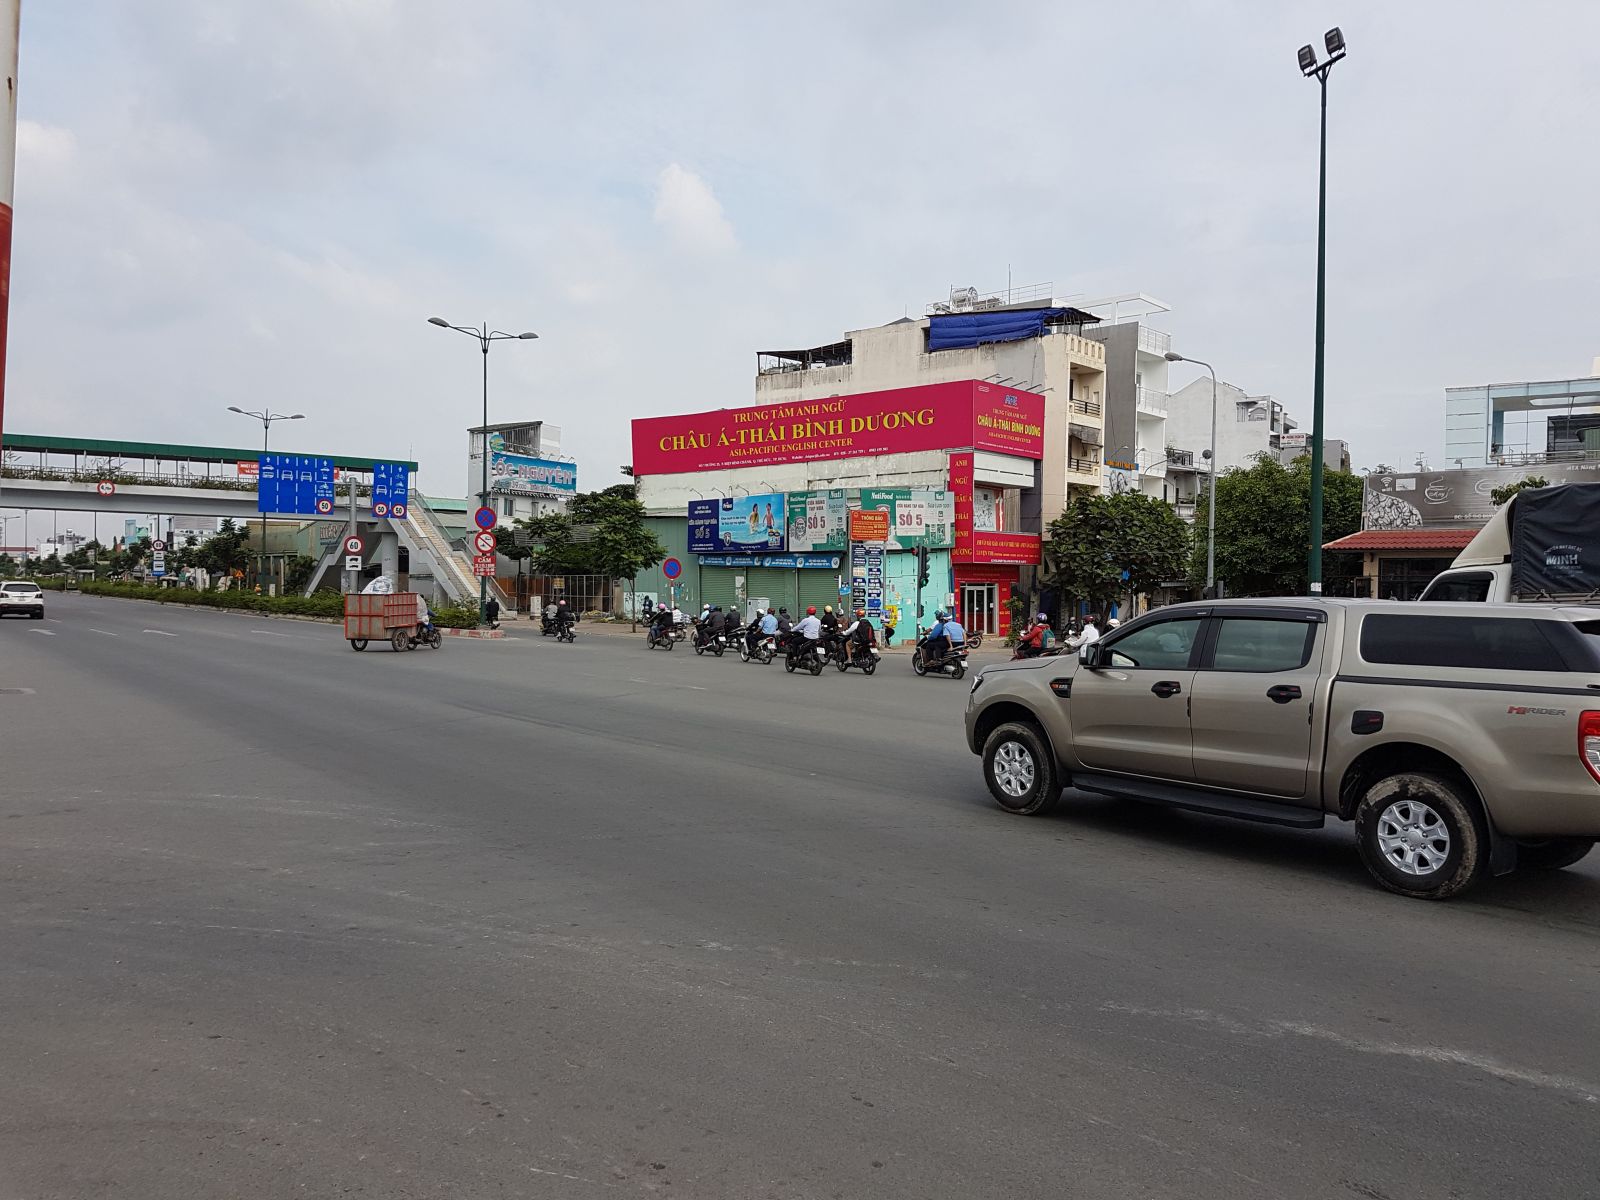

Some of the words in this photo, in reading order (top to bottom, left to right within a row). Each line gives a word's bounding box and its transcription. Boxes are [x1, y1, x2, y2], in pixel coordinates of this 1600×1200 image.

[733, 410, 769, 423] TRUNG
[770, 406, 794, 419] TÂM
[796, 404, 819, 417] ANH
[821, 399, 847, 414] NGỮ
[659, 430, 712, 451] CHÂU
[716, 422, 786, 447] Á-THÁI
[791, 418, 844, 440] BÌNH
[849, 408, 935, 434] DƯƠNG
[977, 413, 993, 428] CHÂU
[993, 415, 1011, 431] Á-THÁI
[1011, 420, 1024, 434] BÌNH
[1024, 424, 1041, 437] DƯƠNG
[729, 444, 780, 458] ASIA-PACIFIC
[781, 441, 817, 454] ENGLISH
[818, 437, 854, 449] CENTER
[495, 457, 514, 477] ỐC
[518, 464, 573, 484] NGUYÊN
[955, 459, 968, 467] ANH
[955, 475, 969, 485] NGỮ
[321, 502, 329, 510] 50
[807, 512, 818, 529] SỐ
[820, 515, 826, 529] 5
[898, 510, 913, 526] SỐ
[915, 513, 923, 526] 5
[350, 541, 359, 550] 60
[477, 556, 491, 564] CẤM
